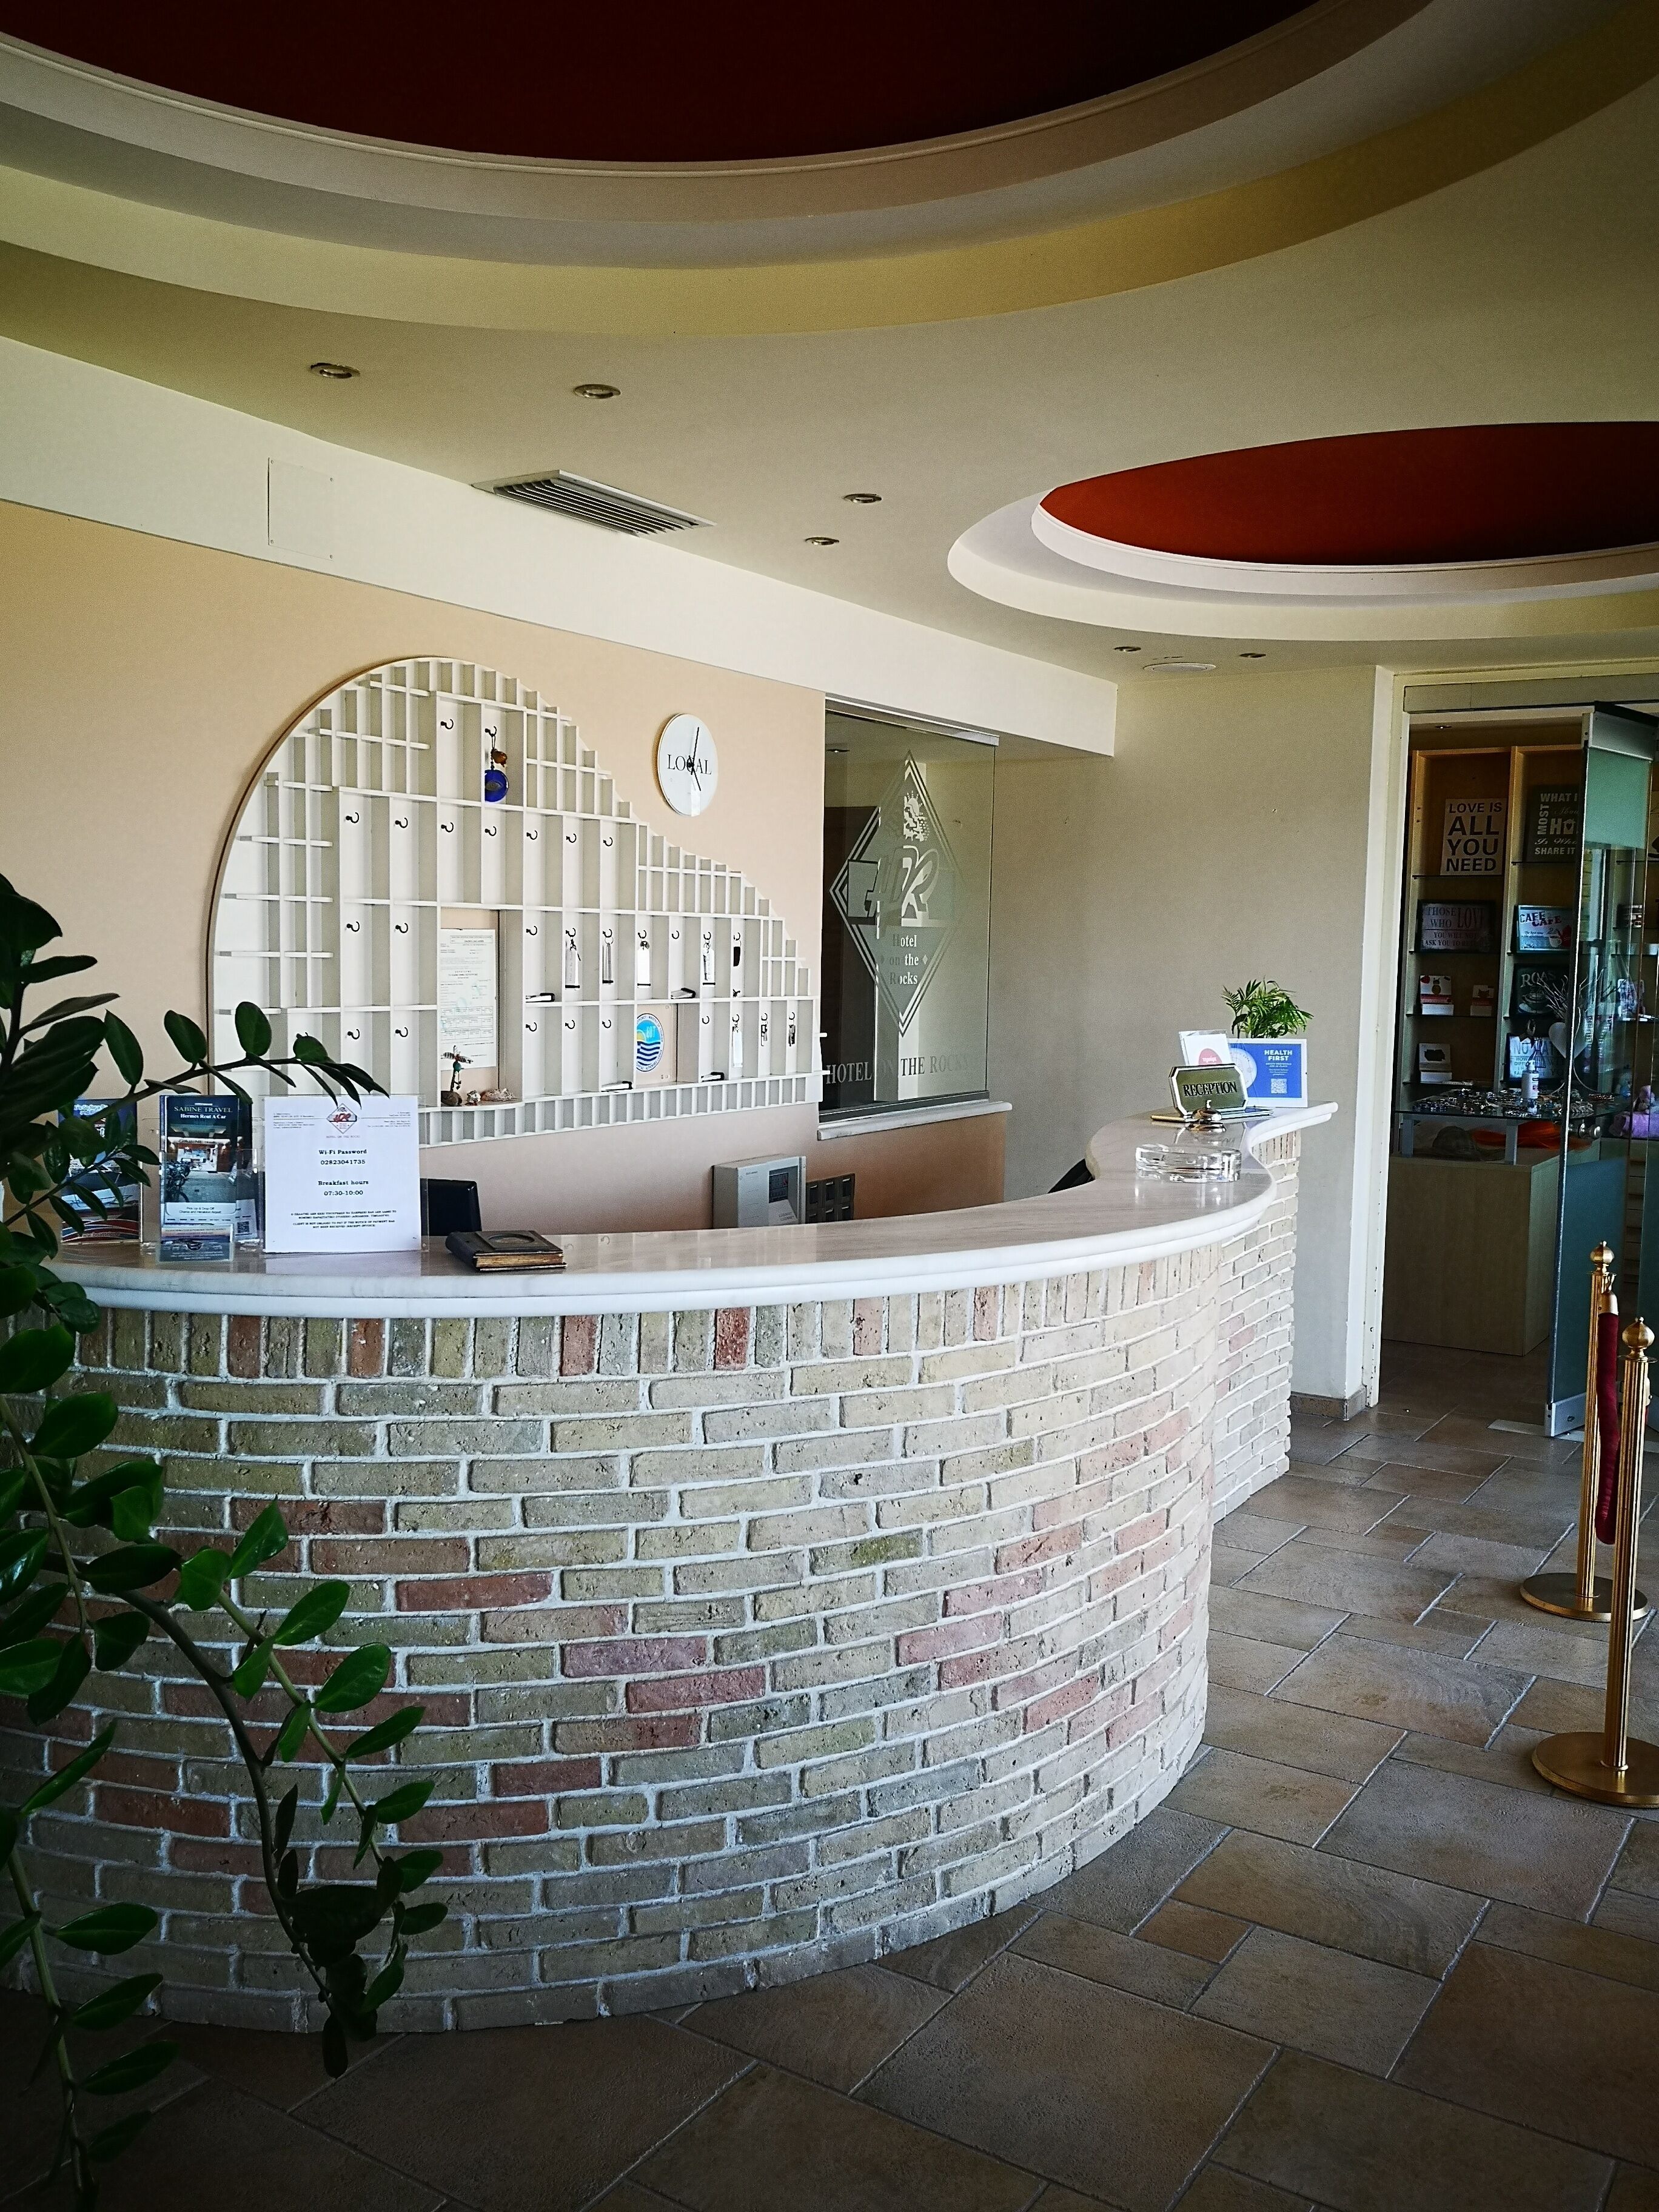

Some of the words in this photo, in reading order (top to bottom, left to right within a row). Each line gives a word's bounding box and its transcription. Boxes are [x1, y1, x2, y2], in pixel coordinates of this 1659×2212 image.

[667, 754, 712, 775] LOCAL
[1540, 793, 1572, 802] WHAT
[1449, 803, 1484, 813] LOVE
[1489, 802, 1503, 813] IS
[1447, 815, 1500, 836] ALL
[1537, 804, 1550, 835] MOST
[1447, 838, 1498, 856] YOU
[1446, 858, 1496, 871] NEED
[1426, 907, 1456, 916] THOSE
[1520, 911, 1546, 923] CAFE
[1430, 919, 1452, 928] WHO
[893, 934, 917, 947] Hotel
[905, 953, 919, 966] the
[890, 971, 918, 985] Rocks
[826, 1062, 872, 1085] HOTEL
[901, 1057, 925, 1076] THE
[1183, 1081, 1238, 1096] RECEPTION
